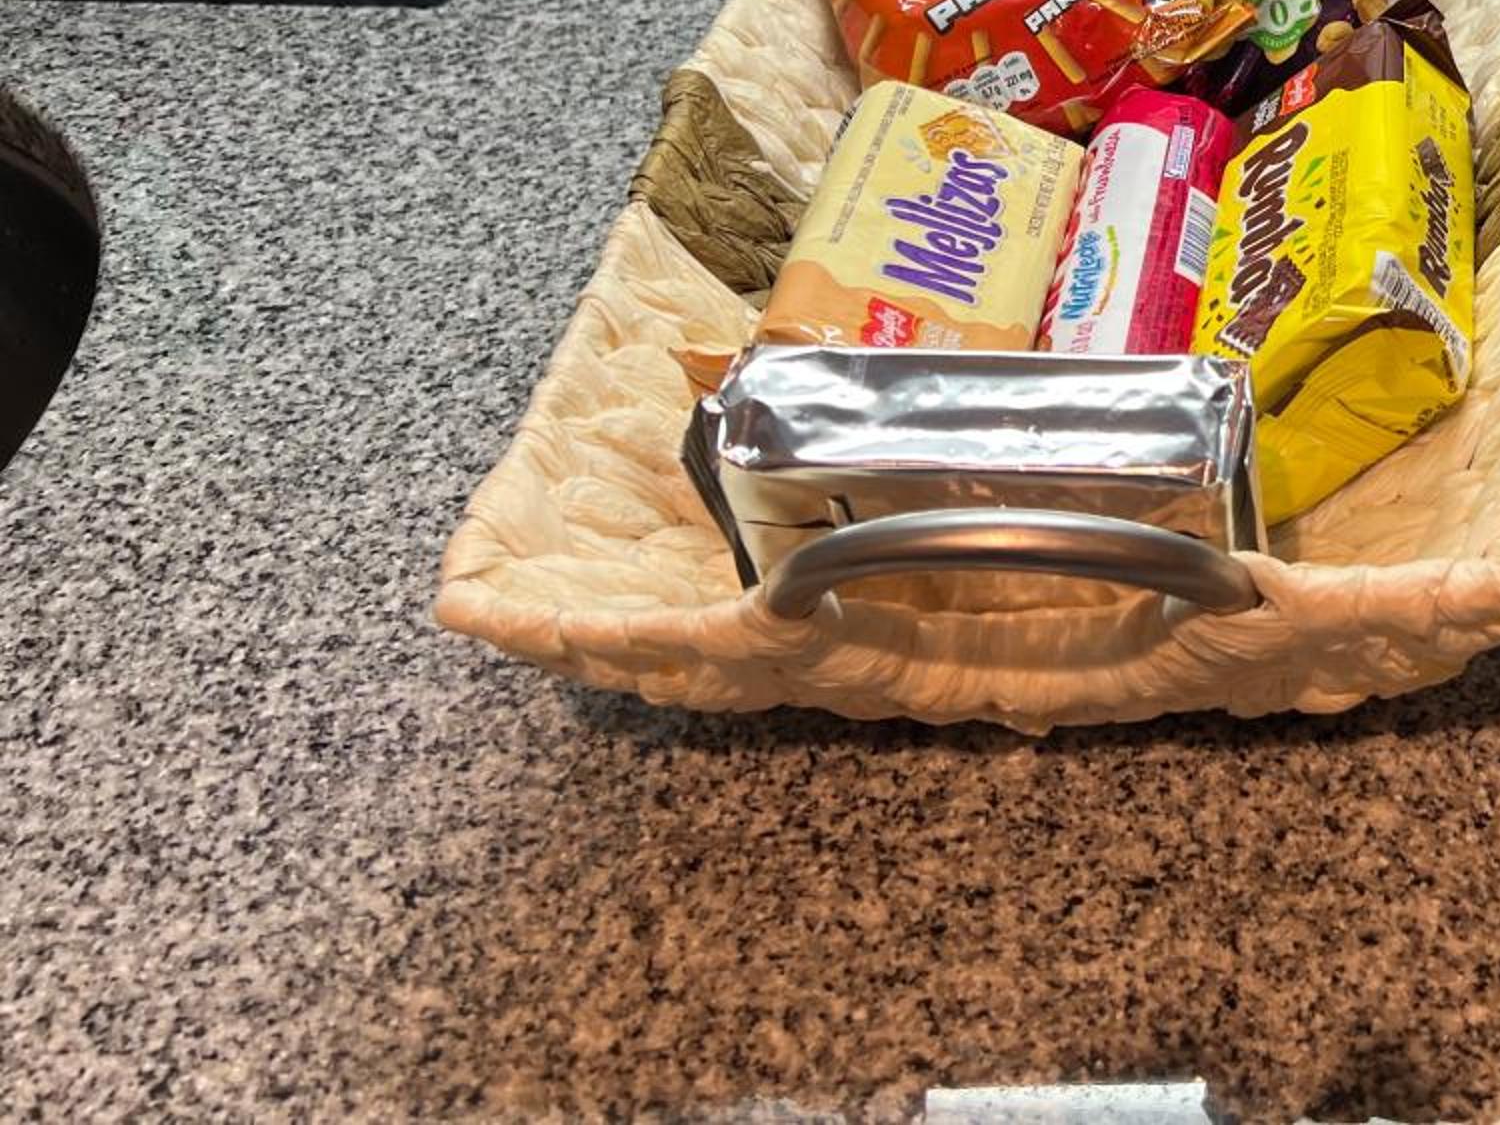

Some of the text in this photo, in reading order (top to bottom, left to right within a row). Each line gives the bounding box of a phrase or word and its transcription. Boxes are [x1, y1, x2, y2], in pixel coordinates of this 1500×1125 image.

[881, 150, 1008, 304] Mellizas
[1229, 122, 1311, 307] Rumba
[1417, 178, 1452, 299] Rumba
